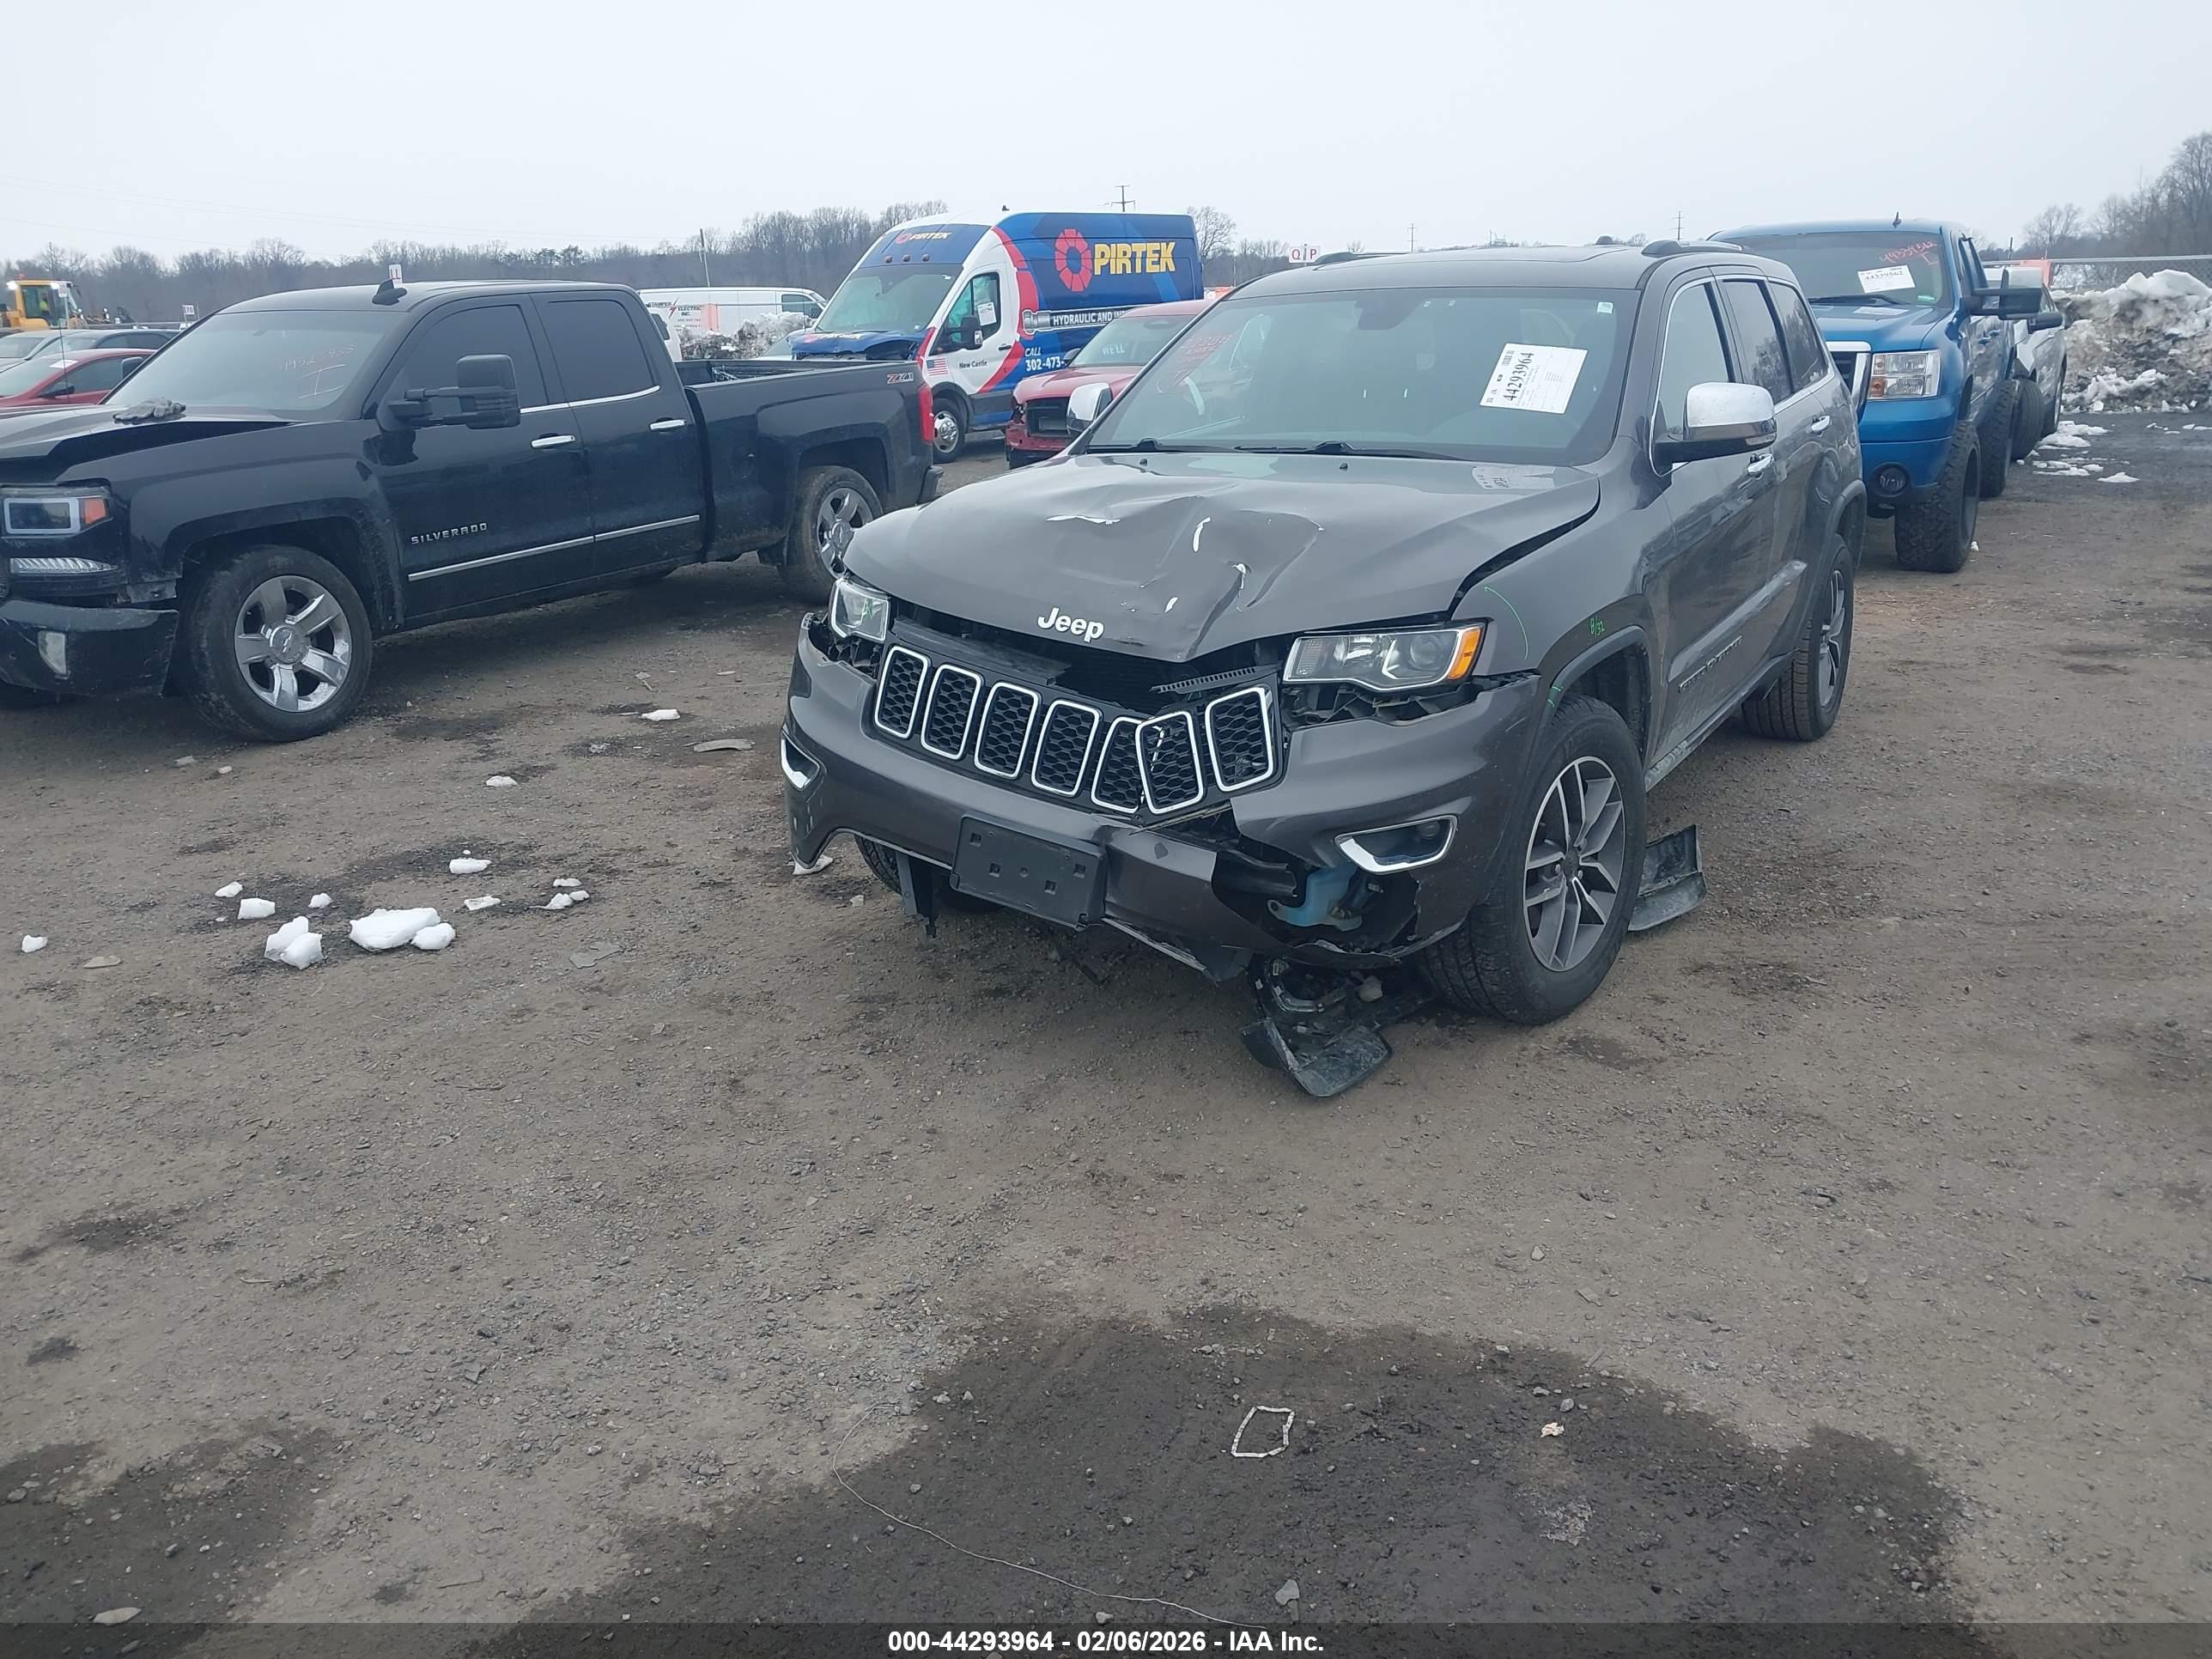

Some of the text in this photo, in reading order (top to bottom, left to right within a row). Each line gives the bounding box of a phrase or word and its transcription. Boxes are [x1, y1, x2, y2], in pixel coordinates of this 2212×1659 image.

[1094, 241, 1176, 275] PIRTEK
[1291, 248, 1317, 260] Q P
[1053, 313, 1097, 326] HYDRAULIC
[1097, 311, 1114, 323] AND
[1024, 347, 1042, 357] CALL
[1025, 356, 1065, 372] 302-473-
[1503, 352, 1534, 402] 44293964
[410, 522, 488, 544] SILVERADO
[1037, 606, 1104, 643] Jeep
